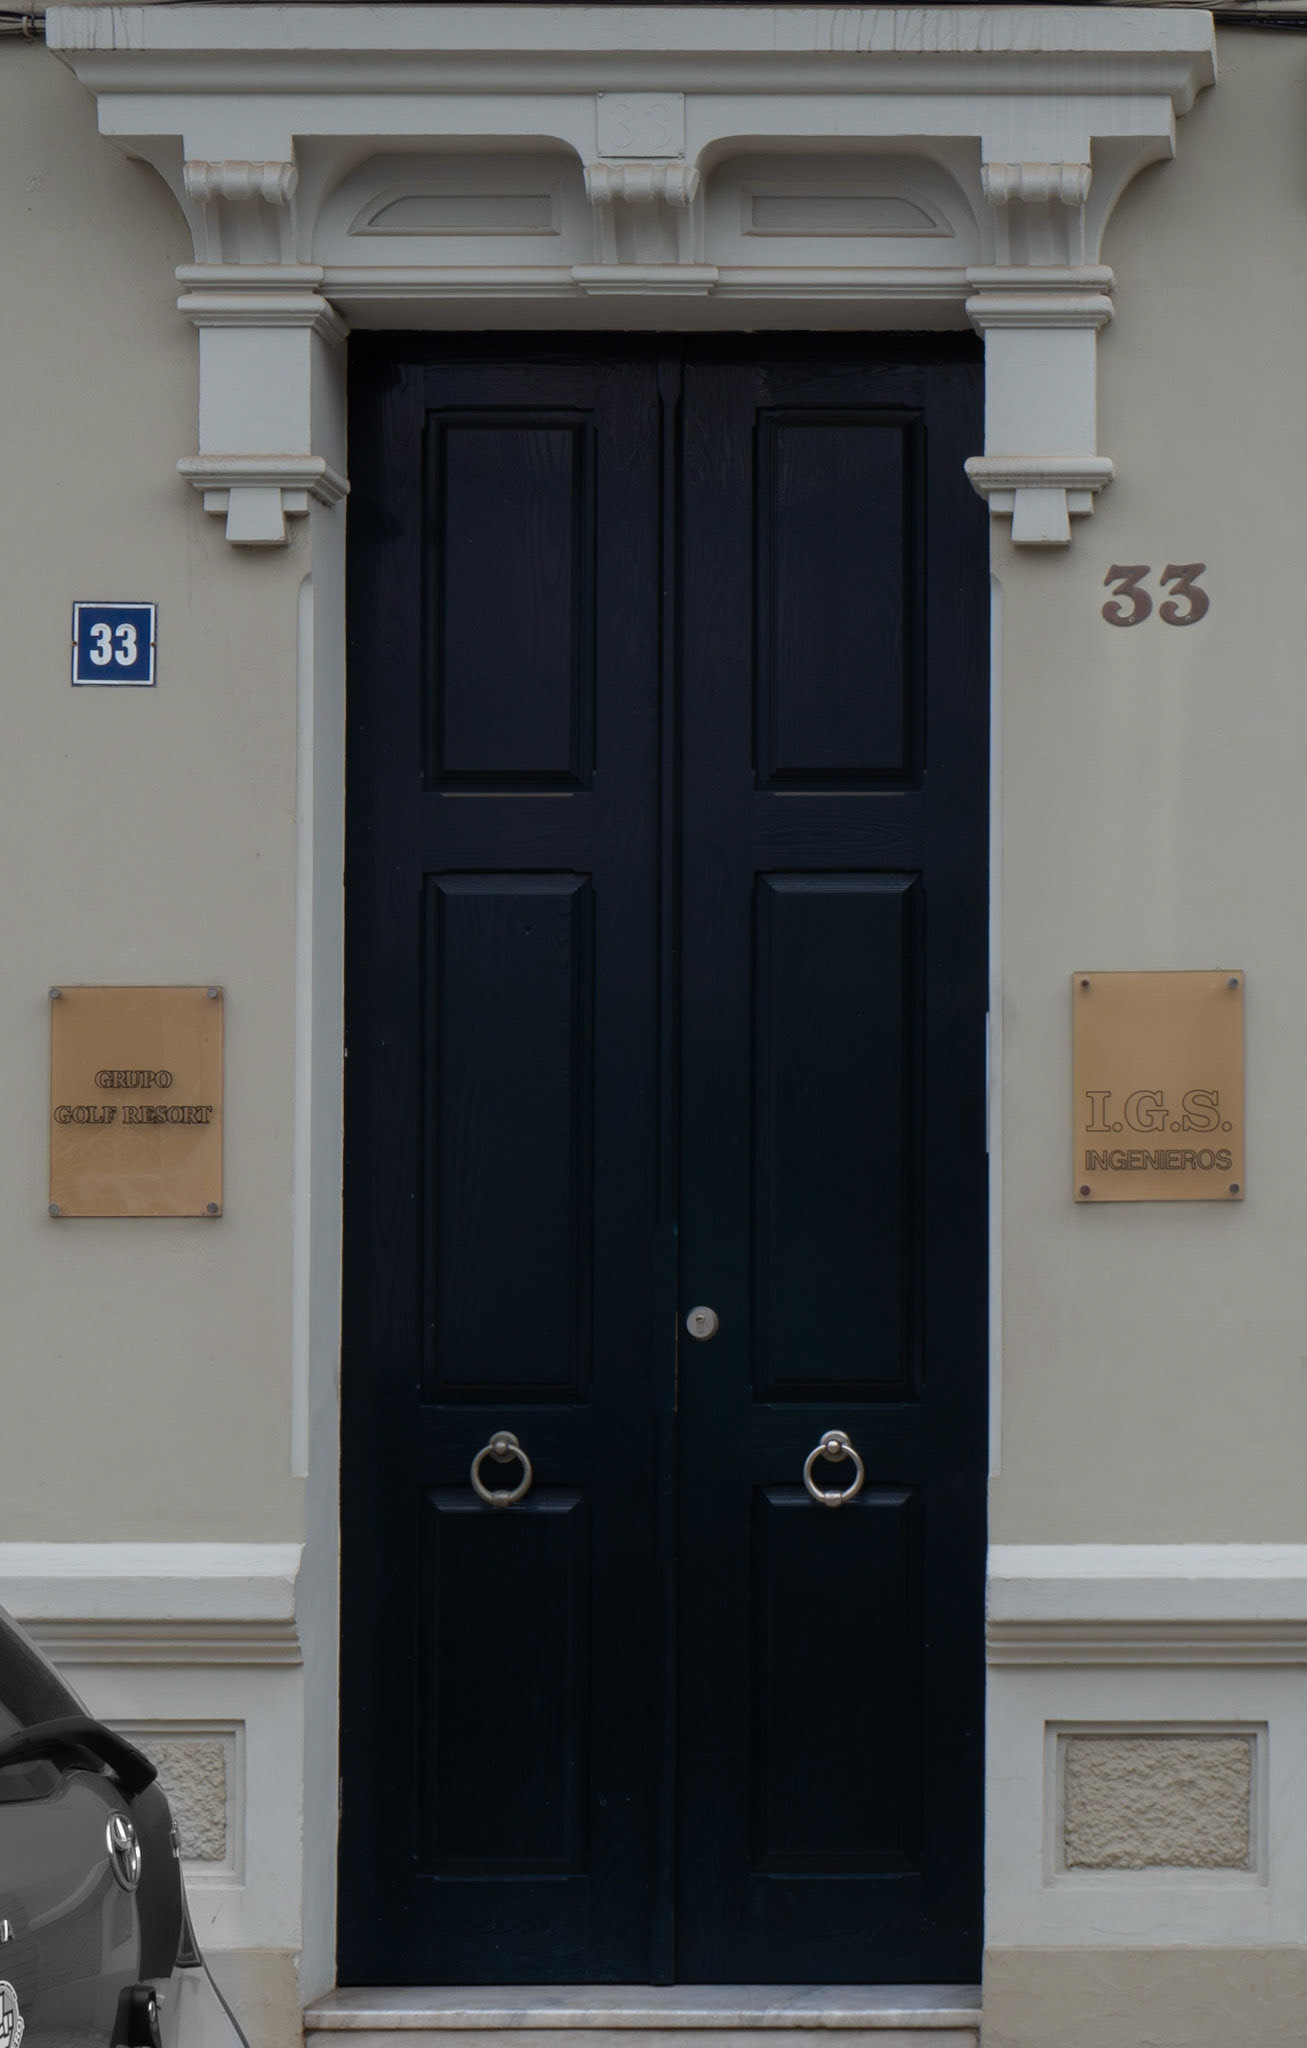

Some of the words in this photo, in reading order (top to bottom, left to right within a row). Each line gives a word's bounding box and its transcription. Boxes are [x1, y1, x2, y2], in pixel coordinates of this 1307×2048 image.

[1102, 563, 1209, 626] 33
[90, 623, 137, 665] 33
[95, 1070, 173, 1088] GRUPO
[54, 1106, 117, 1124] GOLF
[122, 1106, 213, 1124] RESORT
[1085, 1089, 1233, 1132] I.G.S.
[1085, 1149, 1233, 1170] INGENIEROS
